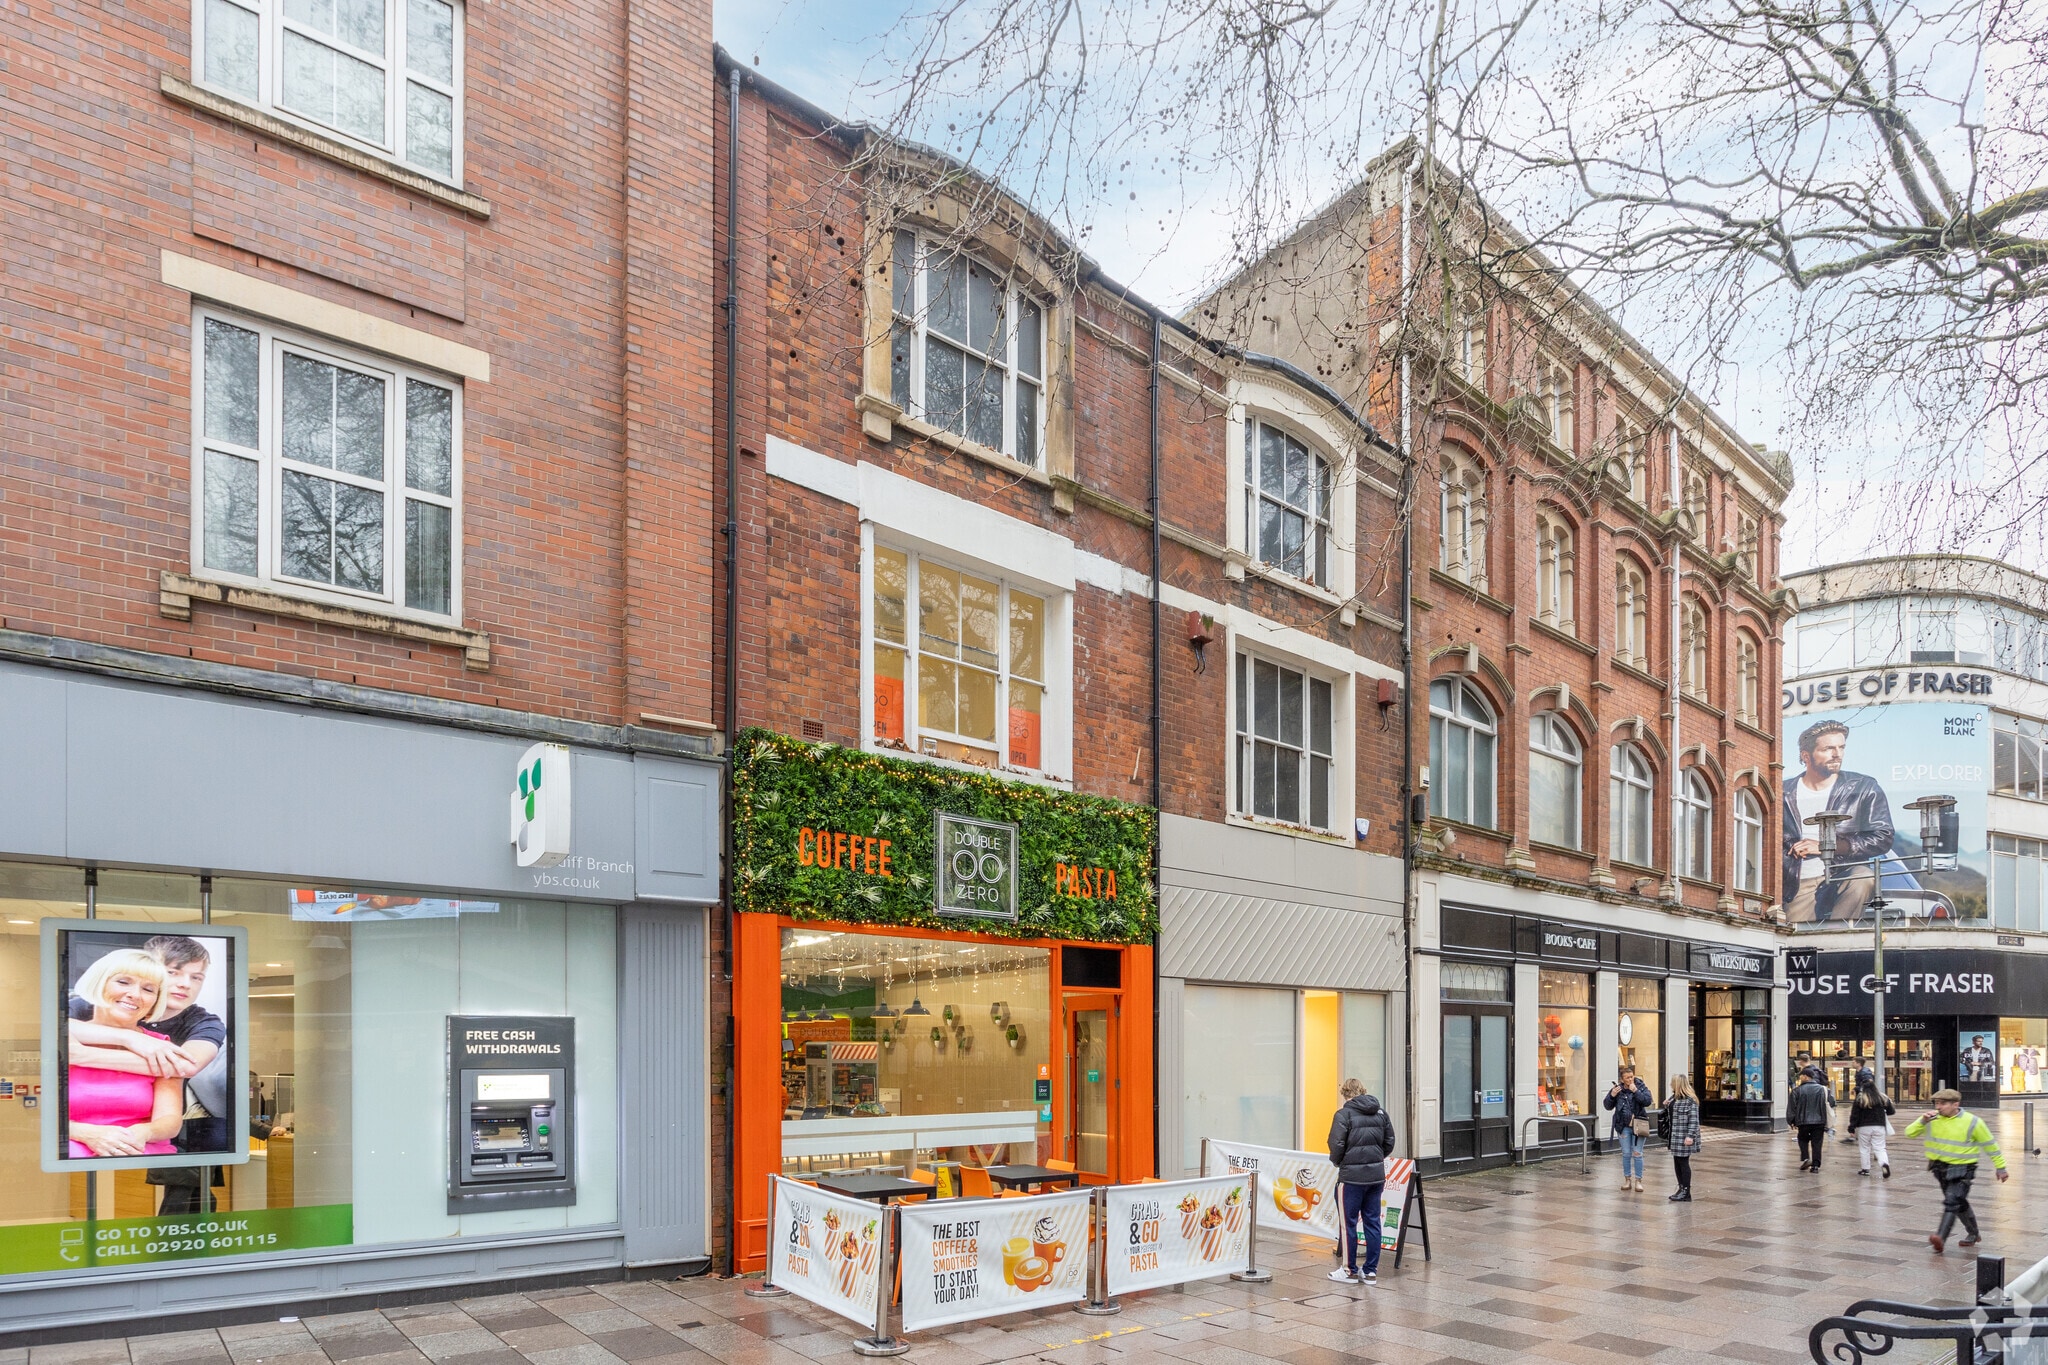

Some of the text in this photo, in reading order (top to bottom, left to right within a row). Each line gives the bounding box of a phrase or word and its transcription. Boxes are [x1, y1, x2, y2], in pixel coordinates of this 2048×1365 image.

[1860, 673, 1899, 696] OF
[1908, 672, 1993, 695] FRASER
[1944, 717, 1975, 727] MONT
[1944, 727, 1975, 737] BLANC
[1010, 751, 1027, 764] OPEN
[1891, 765, 1983, 782] EXPLORER
[955, 831, 1001, 850] DOUBLE
[799, 826, 892, 876] COFFEE
[587, 857, 634, 874] Branch
[533, 872, 601, 889] ybs.co.uk
[1055, 862, 1117, 901] PASTA
[957, 884, 999, 903] ZERO
[1710, 953, 1760, 973] WATERSTONES
[1791, 955, 1812, 969] W
[1909, 973, 1994, 994] FRASER
[466, 1030, 536, 1040] FREE CASH
[1796, 1023, 1837, 1031] HOWELLS
[466, 1044, 561, 1054] WITHDRAWALS
[1228, 1154, 1259, 1170] THE BEST
[96, 1219, 248, 1241] GO TO YBS.CO.UK
[789, 1220, 810, 1249] & GO
[933, 1221, 980, 1240] THE BEST
[1129, 1220, 1159, 1245] & GO
[96, 1233, 277, 1257] CALL 02920 601115
[932, 1239, 967, 1257] COFFEE
[788, 1253, 809, 1278] PASTA
[933, 1254, 978, 1273] SMOOTHIES
[1130, 1252, 1159, 1273] PASTA
[934, 1269, 978, 1290] TO START
[934, 1284, 979, 1304] YOUR DAY!
